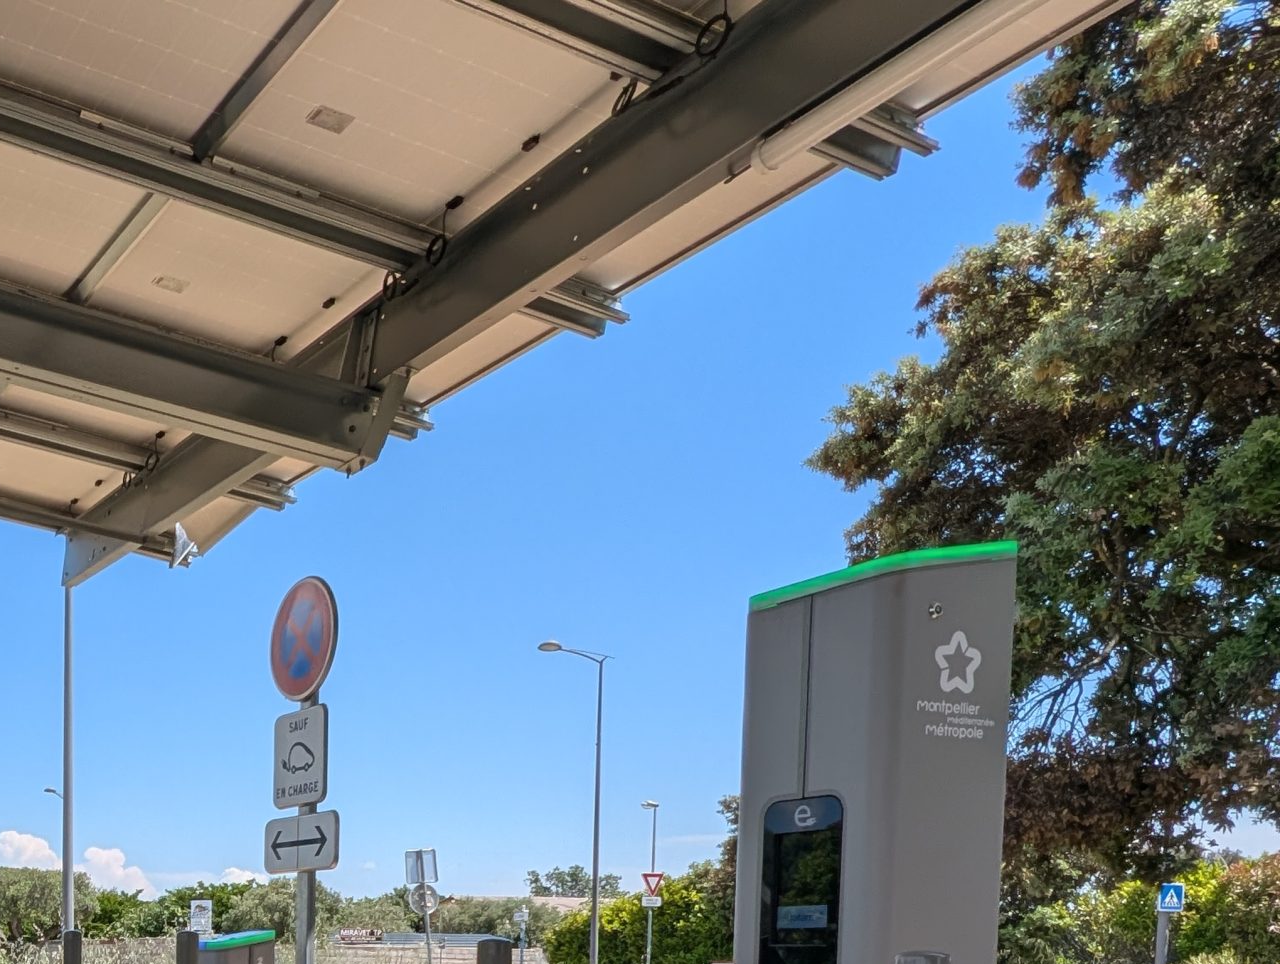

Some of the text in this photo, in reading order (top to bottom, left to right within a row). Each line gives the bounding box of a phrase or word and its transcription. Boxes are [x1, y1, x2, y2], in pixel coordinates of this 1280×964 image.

[289, 717, 309, 733] SAUF
[276, 780, 319, 799] EN CHARGE
